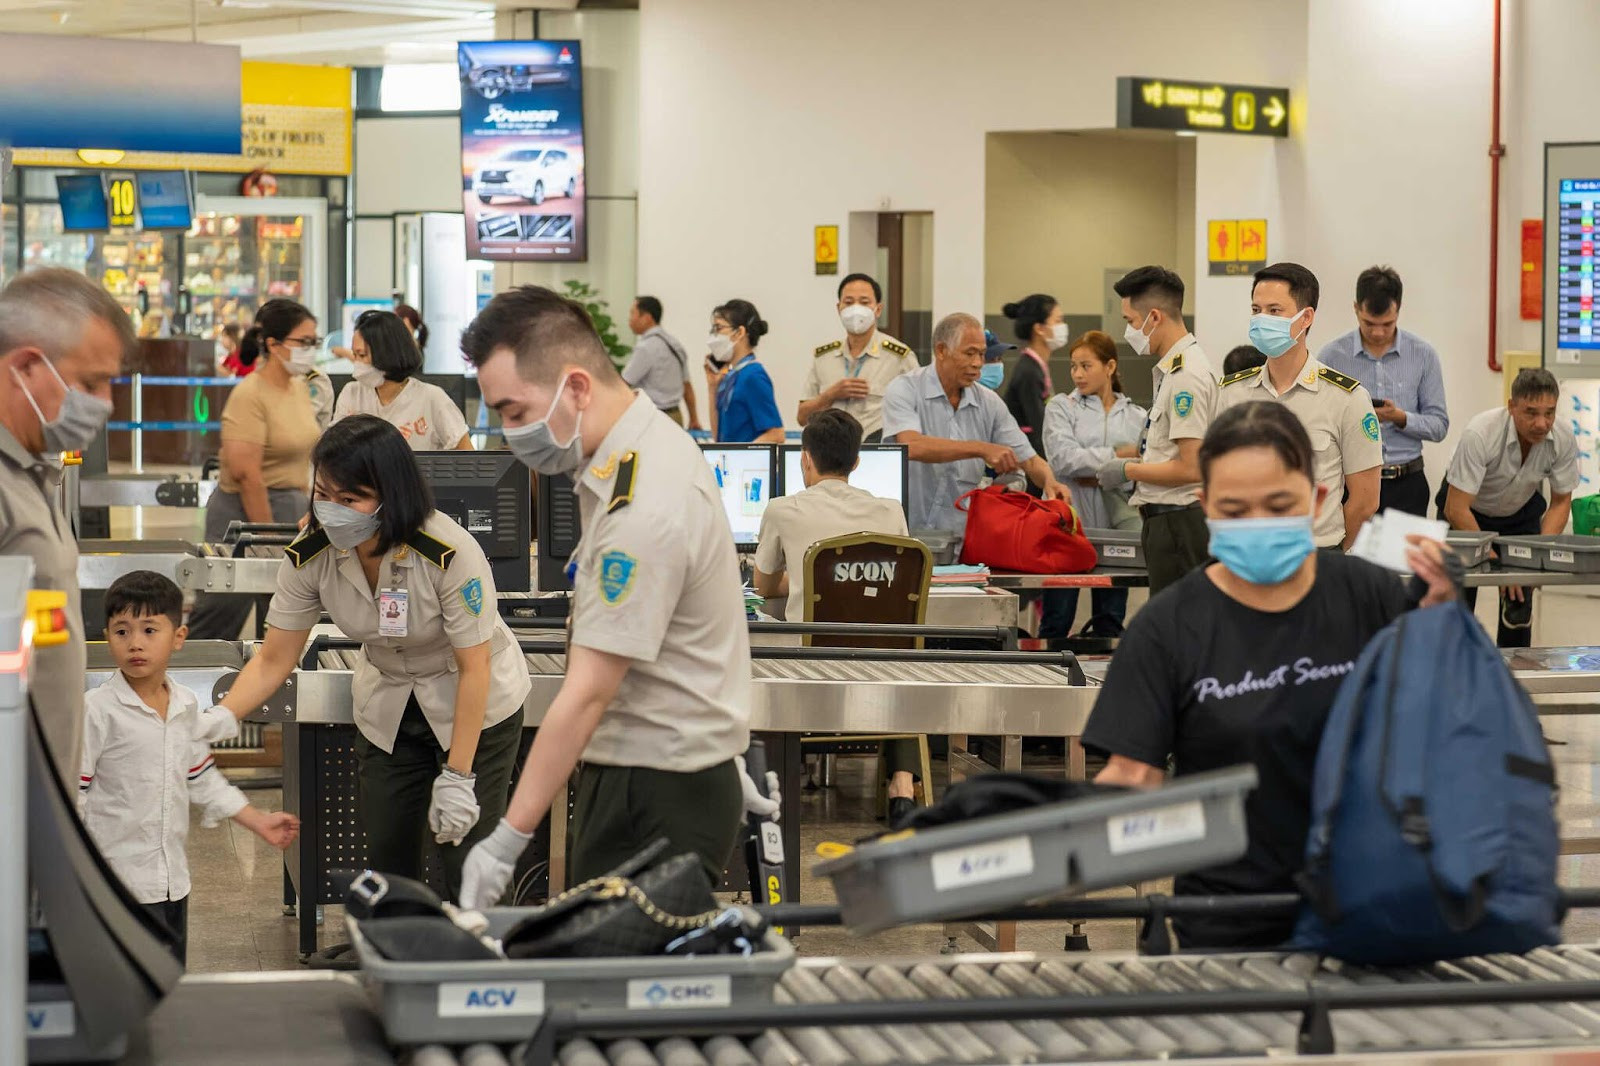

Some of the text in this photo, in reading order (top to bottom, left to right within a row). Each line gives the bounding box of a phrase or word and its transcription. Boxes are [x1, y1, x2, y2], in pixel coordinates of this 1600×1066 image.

[109, 180, 135, 216] 10
[1194, 665, 1290, 703] Product
[466, 988, 516, 1008] ACV
[670, 985, 715, 1001] CMC
